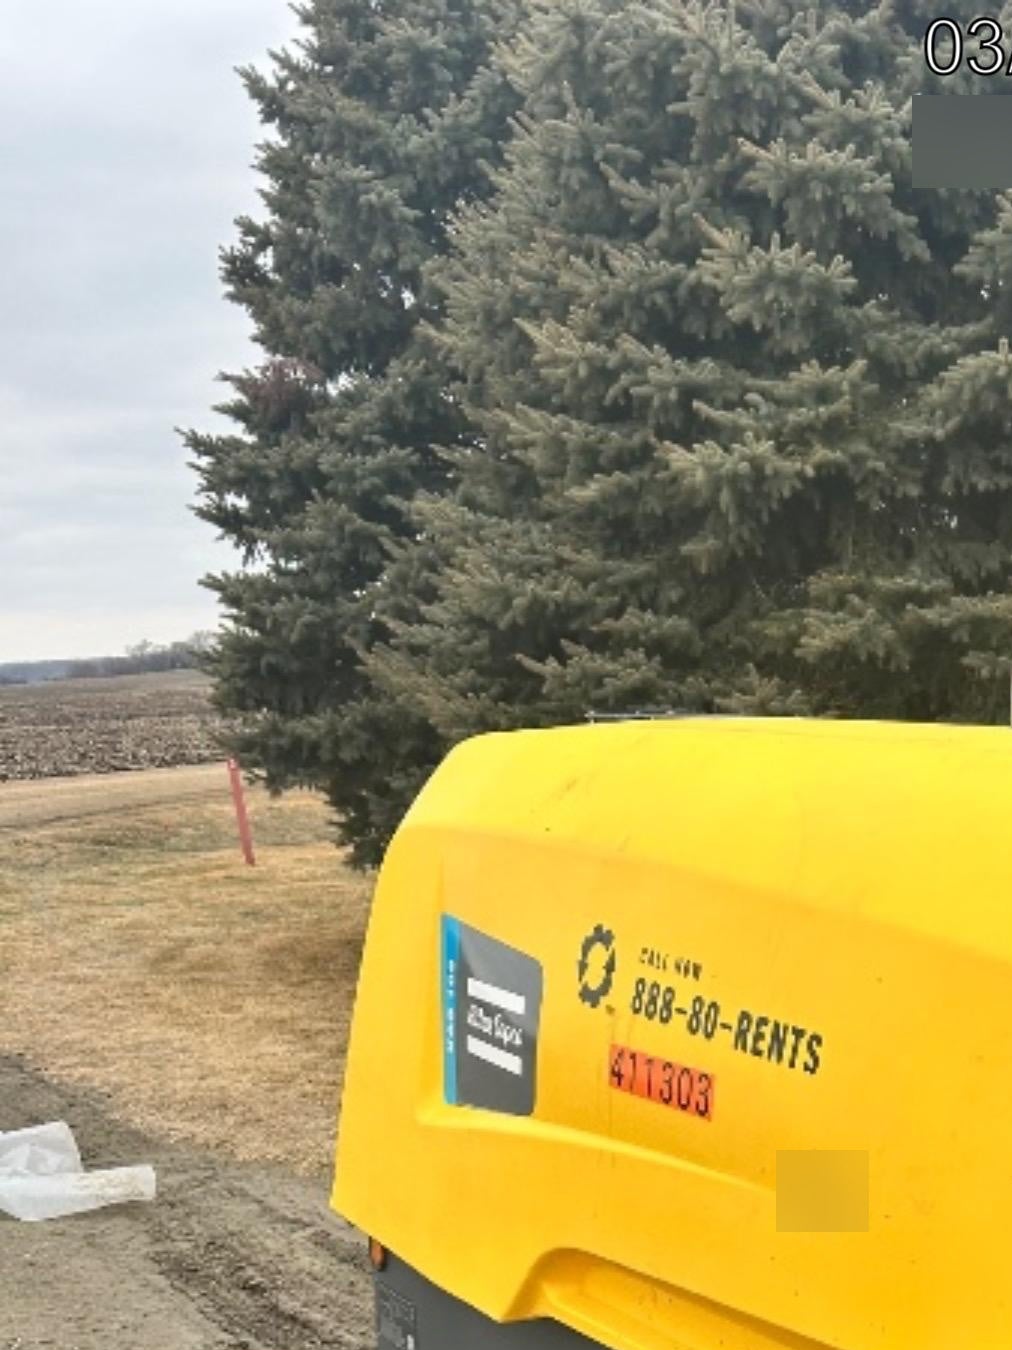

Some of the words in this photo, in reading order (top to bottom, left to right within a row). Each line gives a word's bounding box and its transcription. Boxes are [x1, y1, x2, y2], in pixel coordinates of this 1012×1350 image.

[639, 946, 668, 972] CALL
[674, 956, 704, 982] NOW
[631, 977, 823, 1076] 888-80-RENTS
[611, 1047, 713, 1118] 411303
